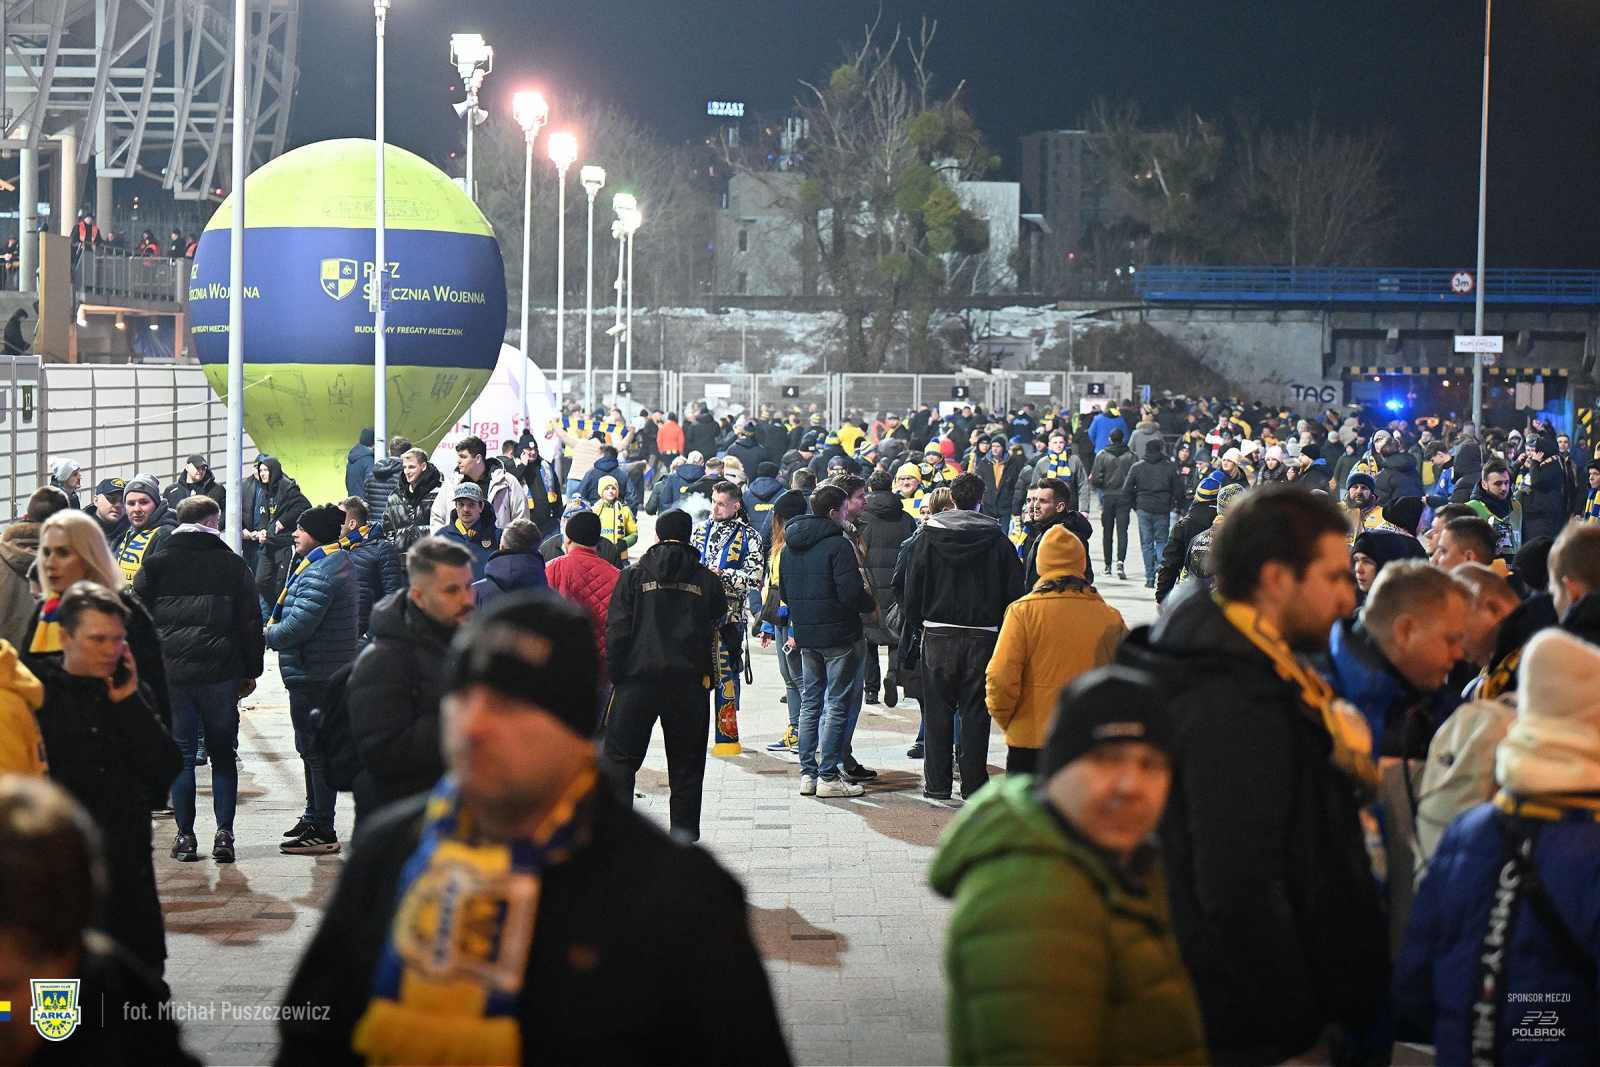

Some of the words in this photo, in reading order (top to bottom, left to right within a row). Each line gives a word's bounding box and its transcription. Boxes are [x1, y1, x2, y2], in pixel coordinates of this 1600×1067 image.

[363, 261, 400, 278] PZ
[1455, 278, 1469, 287] 3m
[208, 283, 260, 299] WOJNA
[362, 283, 431, 301] SCZNIA
[397, 326, 427, 335] FREGATY
[428, 327, 463, 336] MIECZNIK
[620, 382, 626, 391] 5
[787, 387, 794, 396] 4
[957, 387, 963, 396] 3
[1092, 384, 1099, 393] 2
[1291, 384, 1336, 403] TAG
[25, 392, 31, 411] 12
